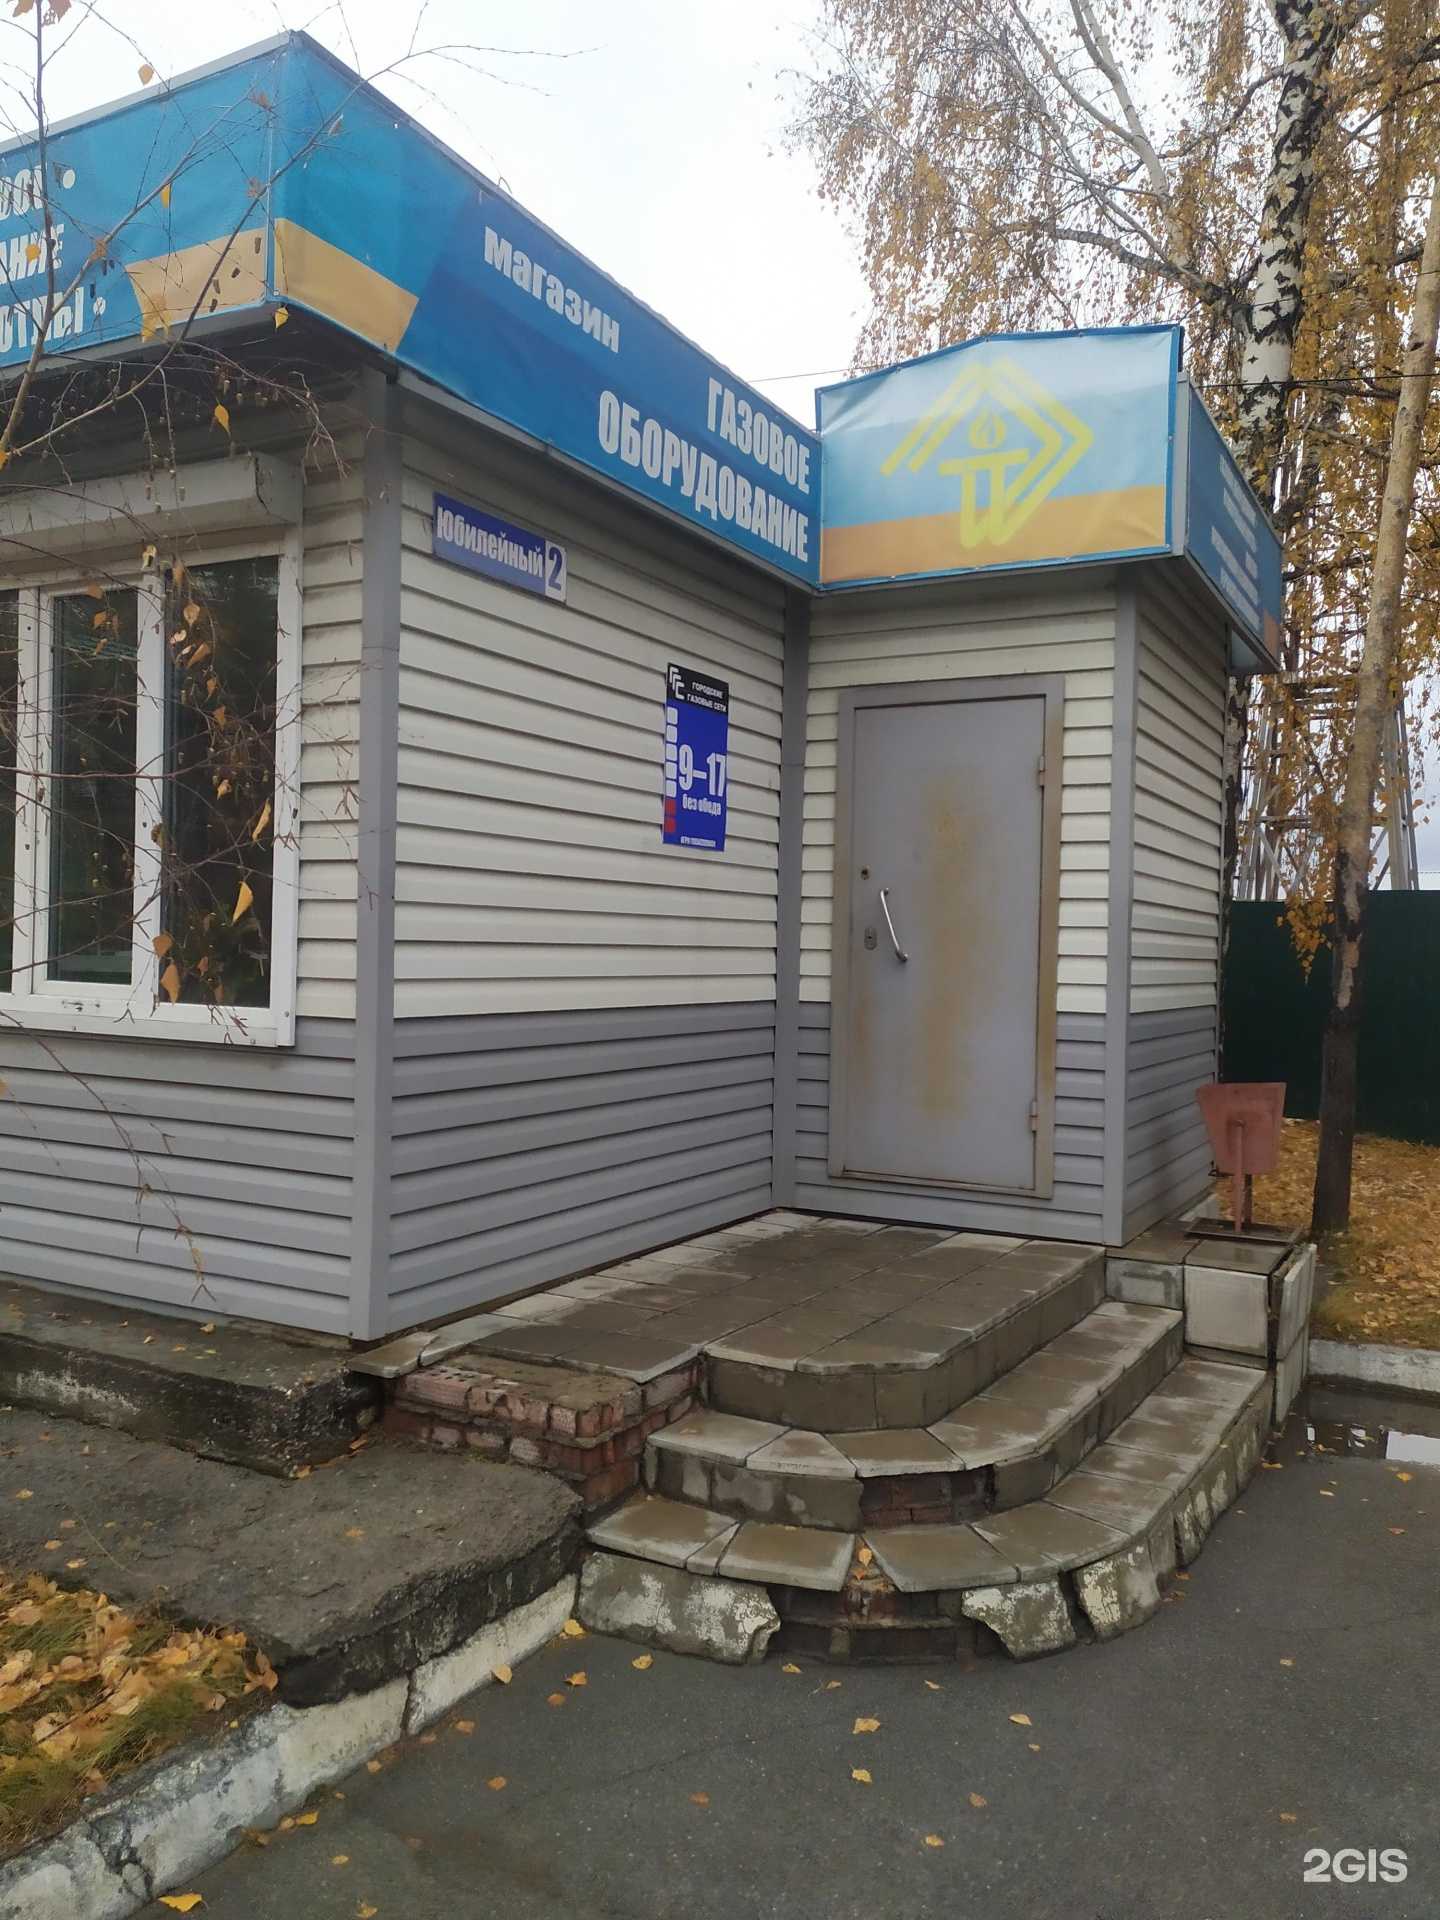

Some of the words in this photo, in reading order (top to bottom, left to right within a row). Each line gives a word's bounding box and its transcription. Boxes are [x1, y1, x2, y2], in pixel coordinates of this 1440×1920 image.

[484, 226, 620, 353] Магазин
[599, 390, 808, 563] ОБОРУДОВАНИЕ
[707, 377, 810, 495] ГАЗОВОЕ
[437, 506, 543, 578] Юбилейный
[548, 546, 563, 592] 2
